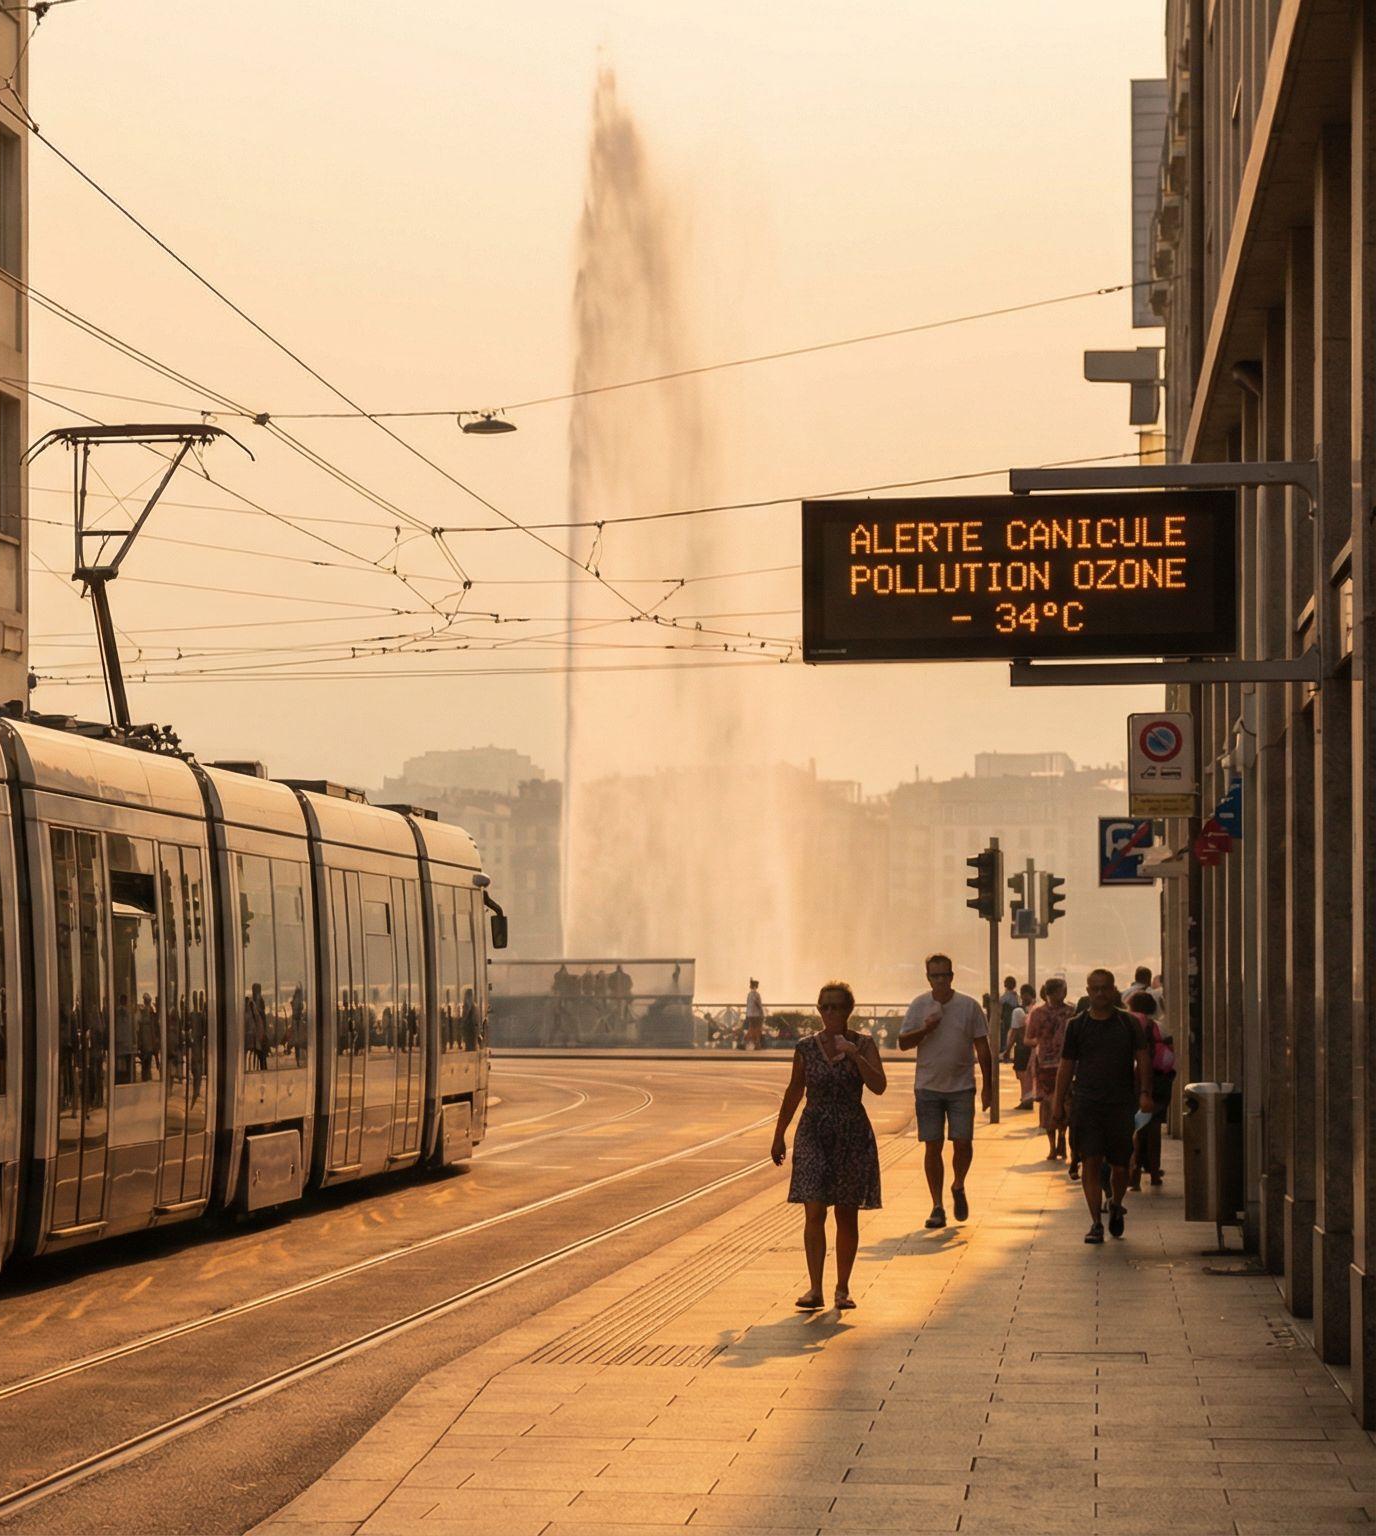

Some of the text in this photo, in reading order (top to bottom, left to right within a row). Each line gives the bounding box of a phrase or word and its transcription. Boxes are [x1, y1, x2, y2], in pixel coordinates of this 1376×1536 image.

[850, 516, 1187, 555] ALERTE CANICULE
[850, 558, 1187, 596] POLLUTION OZONE
[995, 601, 1084, 633] 34°C
